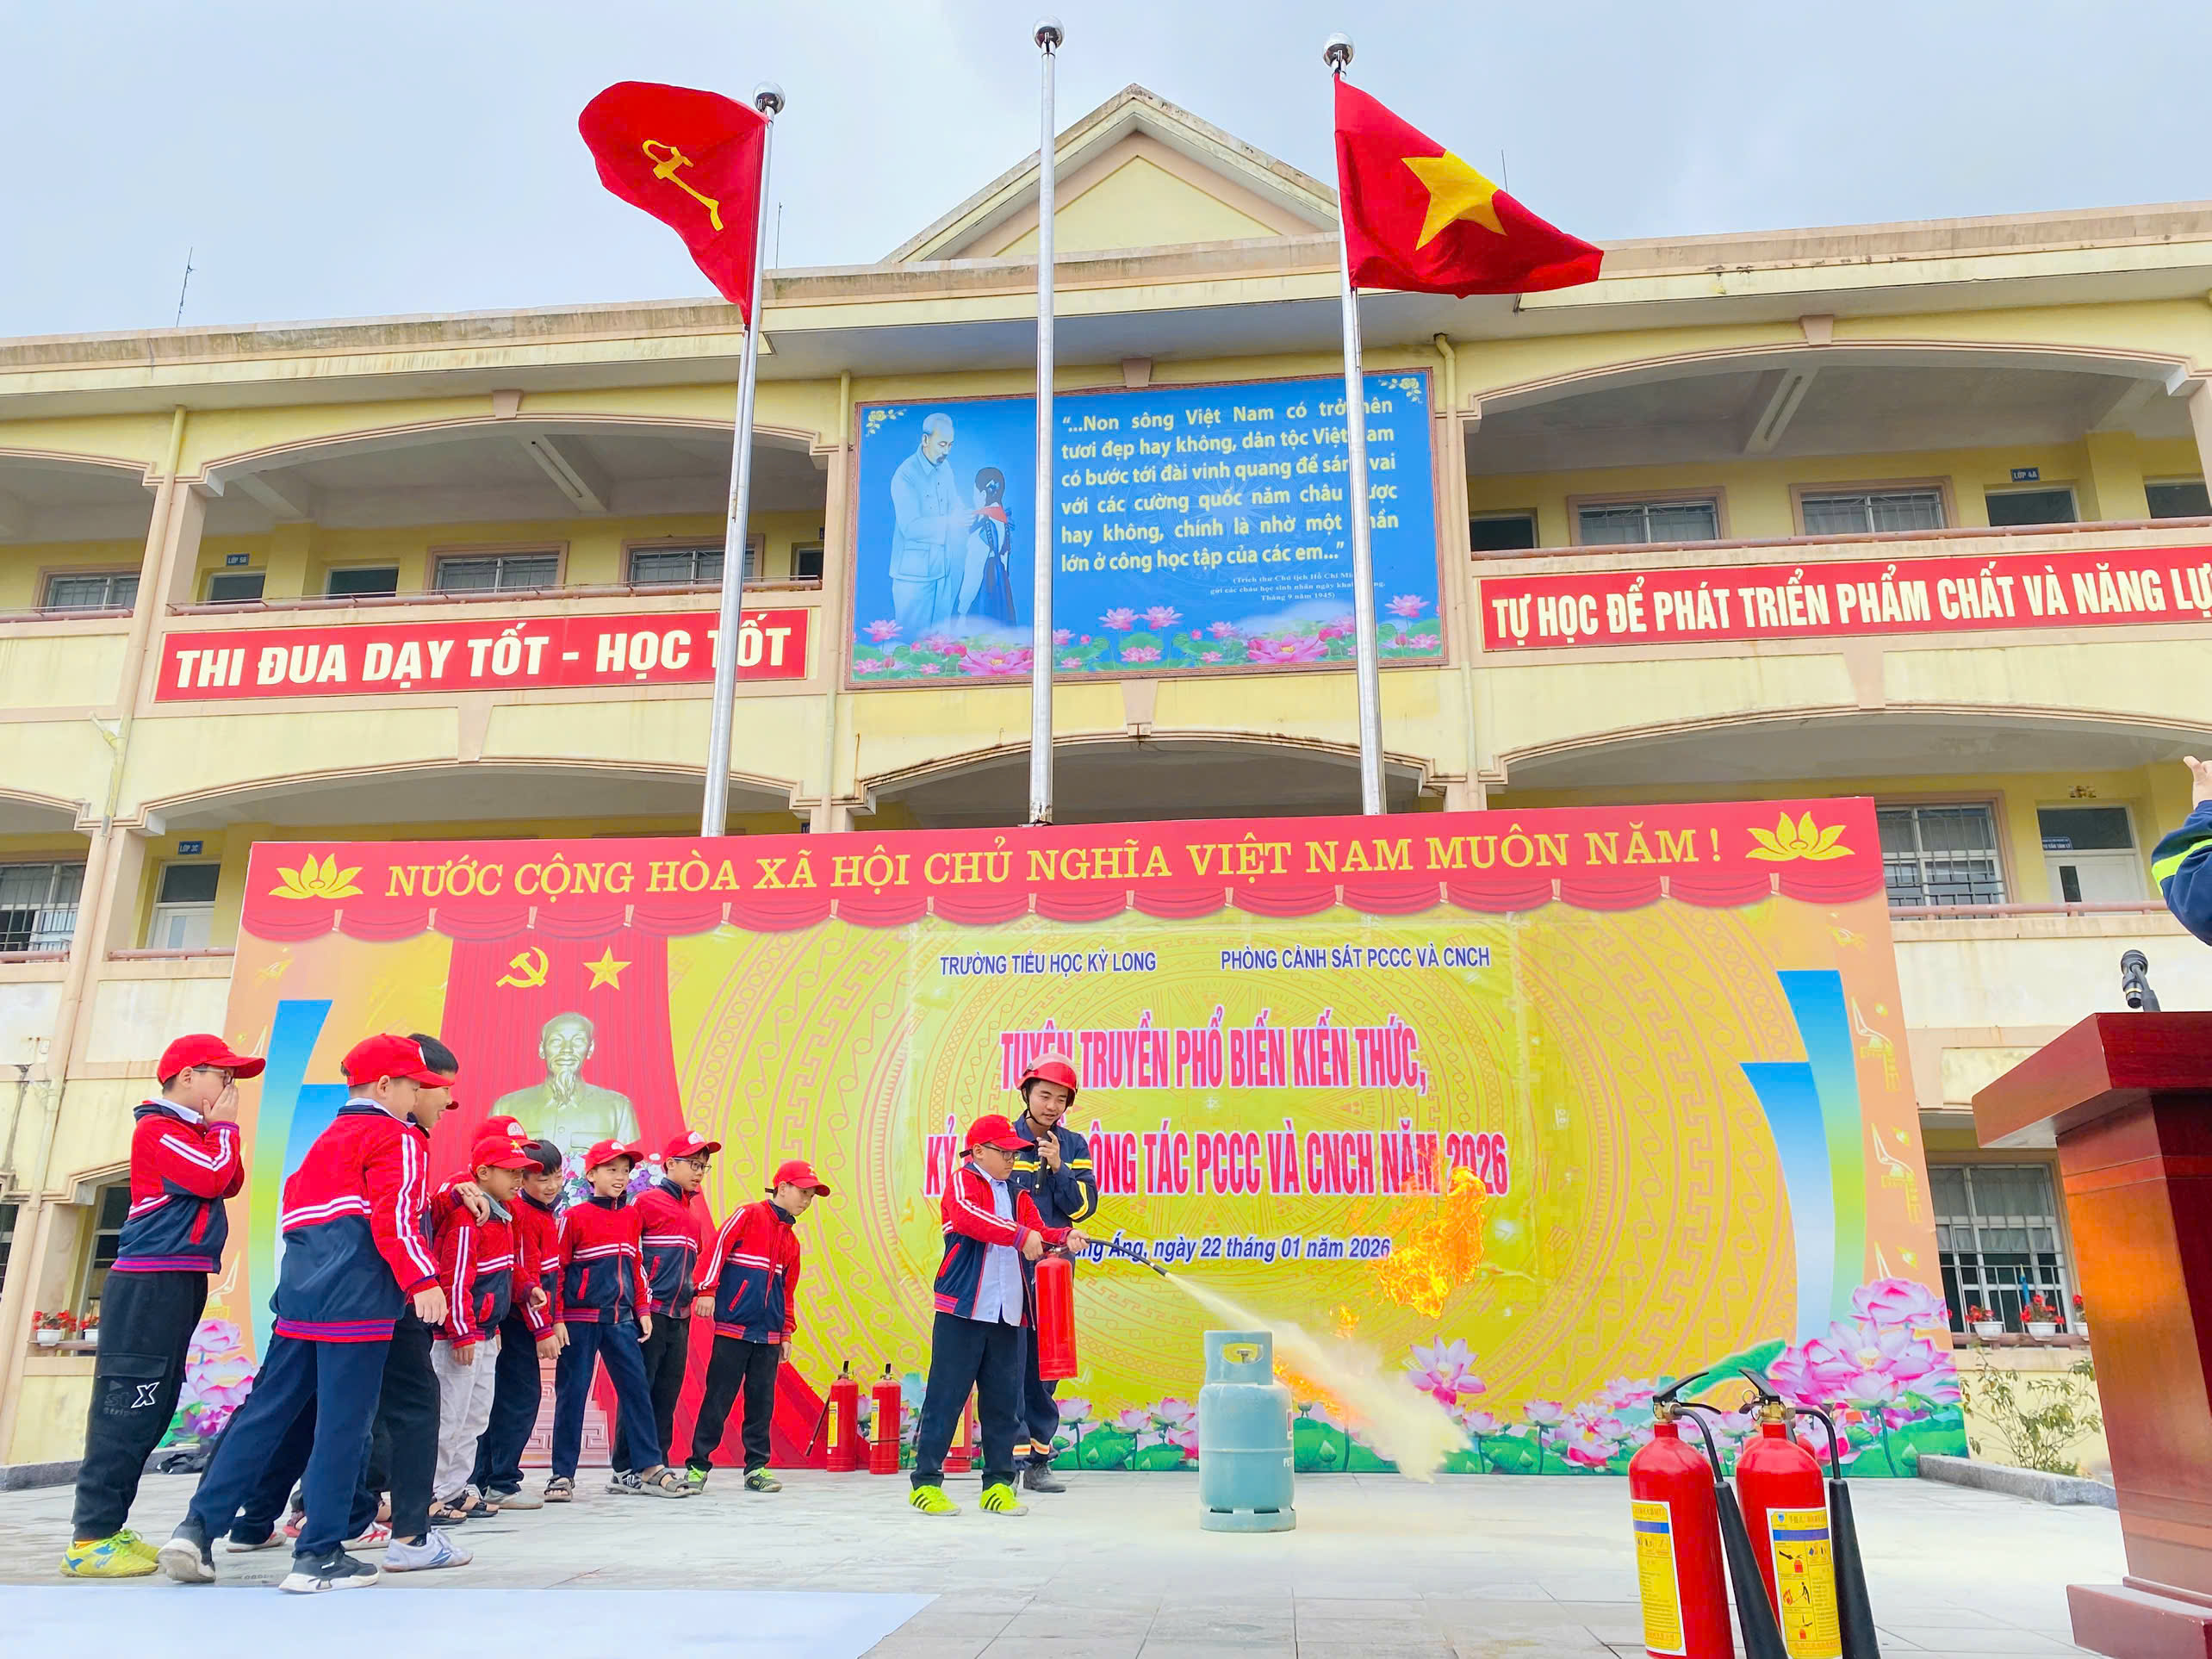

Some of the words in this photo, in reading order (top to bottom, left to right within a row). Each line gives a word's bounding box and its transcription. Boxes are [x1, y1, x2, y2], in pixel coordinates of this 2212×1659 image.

[1131, 412, 1174, 431] sông
[1185, 407, 1221, 428] Việt
[1233, 406, 1274, 422] Nam
[1286, 401, 1308, 419] có
[1319, 398, 1347, 416] trở
[1061, 441, 1096, 459] tươi
[1101, 439, 1134, 461] đẹp
[1140, 438, 1171, 457] hay
[1176, 435, 1237, 454] không,
[1242, 432, 1276, 449] dân
[1280, 429, 1308, 450] tộc
[1313, 426, 1348, 448] Việt
[1366, 428, 1395, 442] am
[1061, 468, 1082, 487] có
[1085, 467, 1129, 486] bước
[1133, 465, 1156, 483] tới
[1160, 463, 1187, 482] đài
[1192, 462, 1230, 479] vinh
[1234, 461, 1291, 482] quang
[1296, 453, 1318, 474] để
[1369, 452, 1395, 470] vai
[1061, 496, 1088, 514] với
[1097, 495, 1126, 513] các
[1134, 493, 1189, 513] cường
[1199, 485, 1243, 511] quốc
[1252, 486, 1290, 505] năm
[1300, 483, 1342, 502] châu
[1369, 484, 1398, 504] ược
[1061, 525, 1092, 548] hay
[1103, 523, 1164, 544] không,
[1174, 518, 1223, 537] chính
[1233, 517, 1249, 535] là
[1260, 514, 1296, 533] nhờ
[1306, 513, 1342, 536] một
[1061, 553, 1090, 572] lớn
[1093, 551, 1106, 570] ở
[1109, 552, 1153, 573] công
[1157, 550, 1190, 571] học
[1193, 547, 1222, 570] tập
[1227, 545, 1258, 564] của
[1261, 544, 1290, 562] các
[1492, 593, 1531, 646] TỰ
[1537, 594, 1599, 643] HỌC
[1606, 575, 1647, 633] ĐỂ
[1653, 581, 1730, 631] PHÁT
[1738, 568, 1830, 628] TRIỂN
[1836, 563, 1931, 624] PHẨM
[1936, 561, 2016, 620] CHẤT
[2022, 564, 2068, 617] VÀ
[2072, 562, 2164, 613] NĂNG
[2170, 562, 2212, 618] LỰ
[176, 649, 245, 688] THI
[257, 643, 346, 685] ĐUA
[362, 640, 455, 688] DẠY
[467, 622, 550, 677] TỐT
[595, 631, 692, 680] HỌC
[385, 854, 503, 897] NƯỚC
[514, 853, 634, 903] CỘNG
[646, 849, 739, 892] HÒA
[753, 849, 817, 889] XÃ
[830, 844, 910, 895] HỘI
[924, 836, 1013, 885] CHỦ
[1027, 839, 1171, 880] NGHĨA
[1186, 832, 1291, 884] VIỆT
[1306, 839, 1414, 873] NAM
[1426, 823, 1569, 869] MUÔN
[1585, 821, 1699, 866] NĂM
[940, 952, 1007, 975] TRƯỜNG
[1011, 950, 1045, 973] TIỂU
[1050, 954, 1083, 977] HỌC
[1087, 948, 1109, 972] KỲ
[1113, 952, 1156, 972] LONG
[1221, 946, 1277, 969] PHÒNG
[1282, 945, 1327, 969] CẢNH
[1332, 945, 1363, 968] SÁT
[1367, 948, 1412, 967] PCCC
[1416, 943, 1438, 967] VÀ
[1443, 947, 1490, 966] CNCH
[1080, 1011, 1168, 1088] TRUYỀN
[1176, 1006, 1222, 1088] PHỔ
[1230, 1010, 1286, 1087] BIẾN
[1292, 1010, 1350, 1087] KIẾN
[1355, 1016, 1426, 1094] THỨC,
[1089, 1121, 1136, 1194] ÔNG
[1144, 1121, 1189, 1194] TÁC
[1196, 1133, 1260, 1194] PCCC
[1267, 1120, 1300, 1193] VÀ
[1307, 1133, 1374, 1194] CNCH
[1380, 1119, 1440, 1193] NĂM
[1446, 1133, 1508, 1195] 2026
[1153, 1236, 1196, 1262] ngày
[1201, 1237, 1221, 1257] 22
[1227, 1236, 1276, 1263] tháng
[1281, 1237, 1301, 1258] 01
[1306, 1237, 1344, 1258] năm
[1349, 1238, 1391, 1258] 2026
